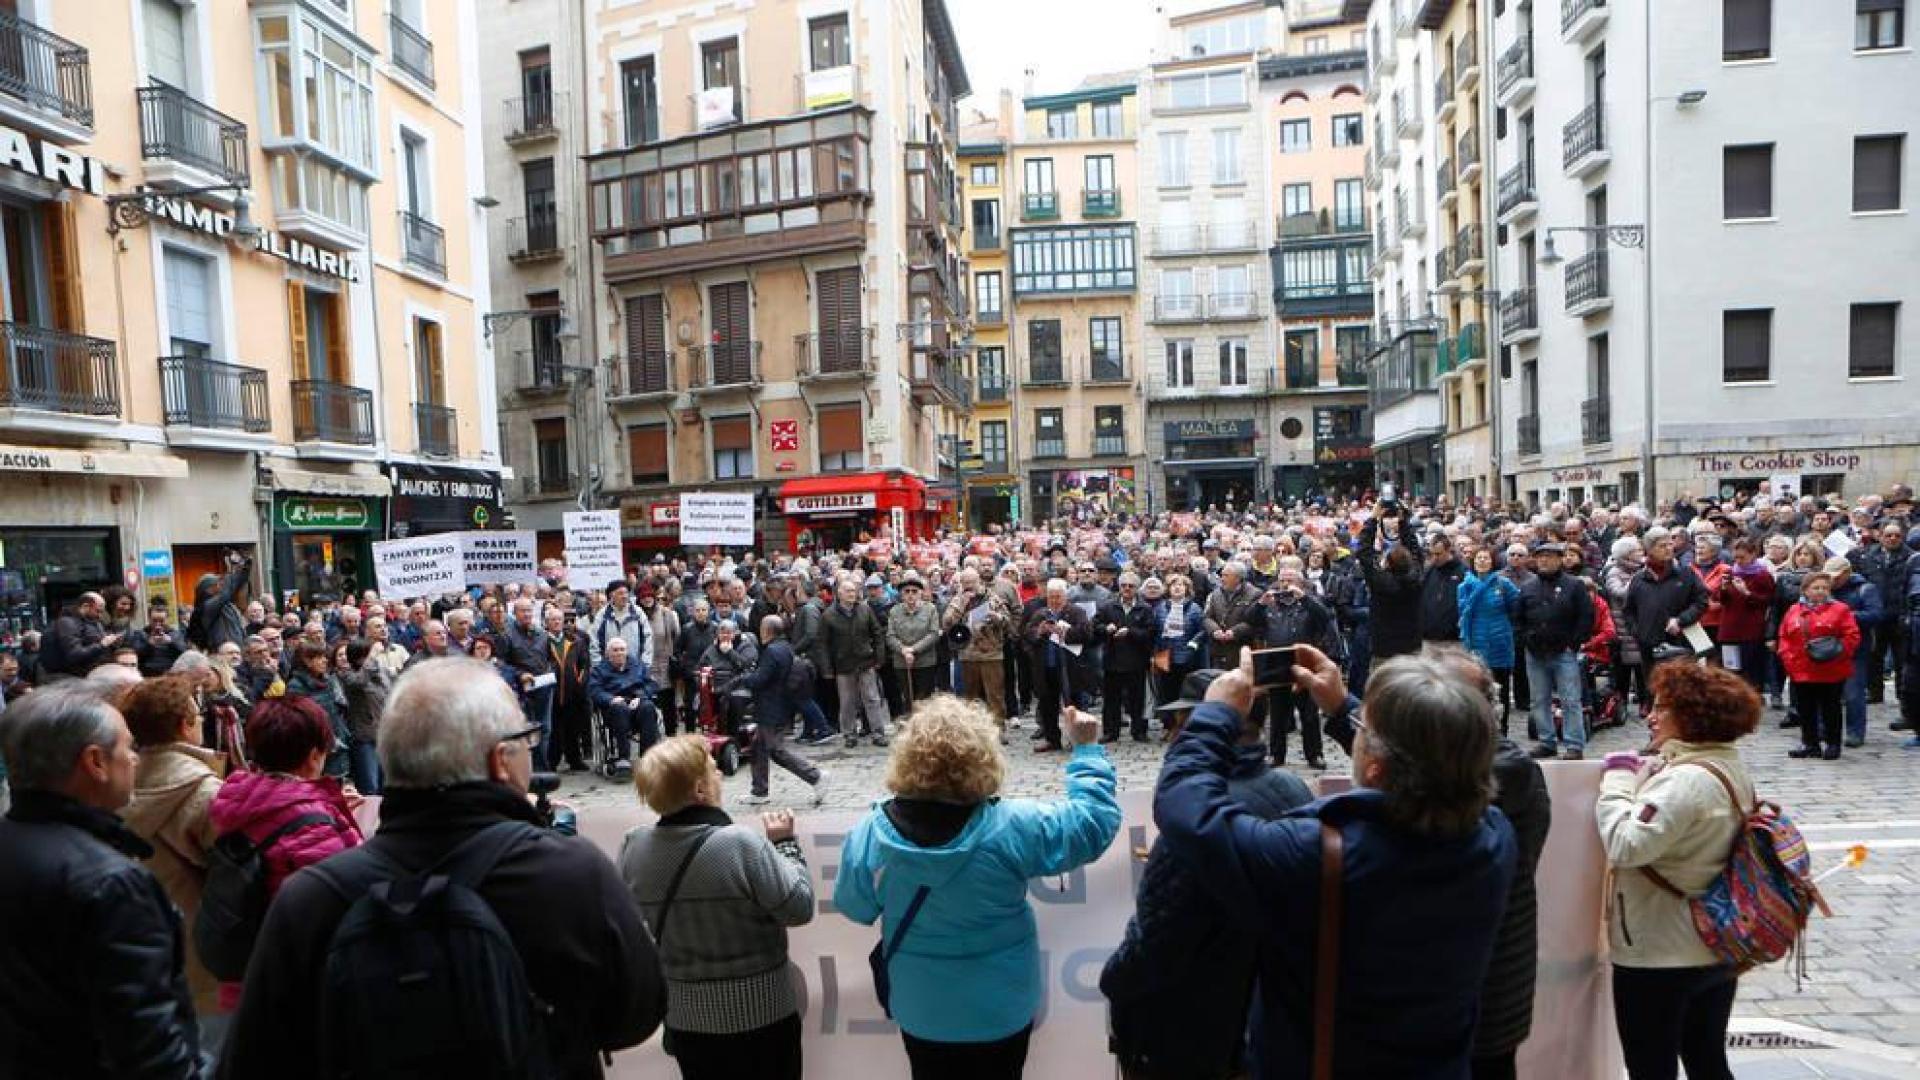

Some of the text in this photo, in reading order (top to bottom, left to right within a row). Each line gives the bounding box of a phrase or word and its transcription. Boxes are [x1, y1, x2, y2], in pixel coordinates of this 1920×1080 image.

[144, 195, 362, 284] INMOILIARIA
[1697, 451, 1861, 471] The Cookie Shop
[797, 495, 864, 509] GUTIERREZ
